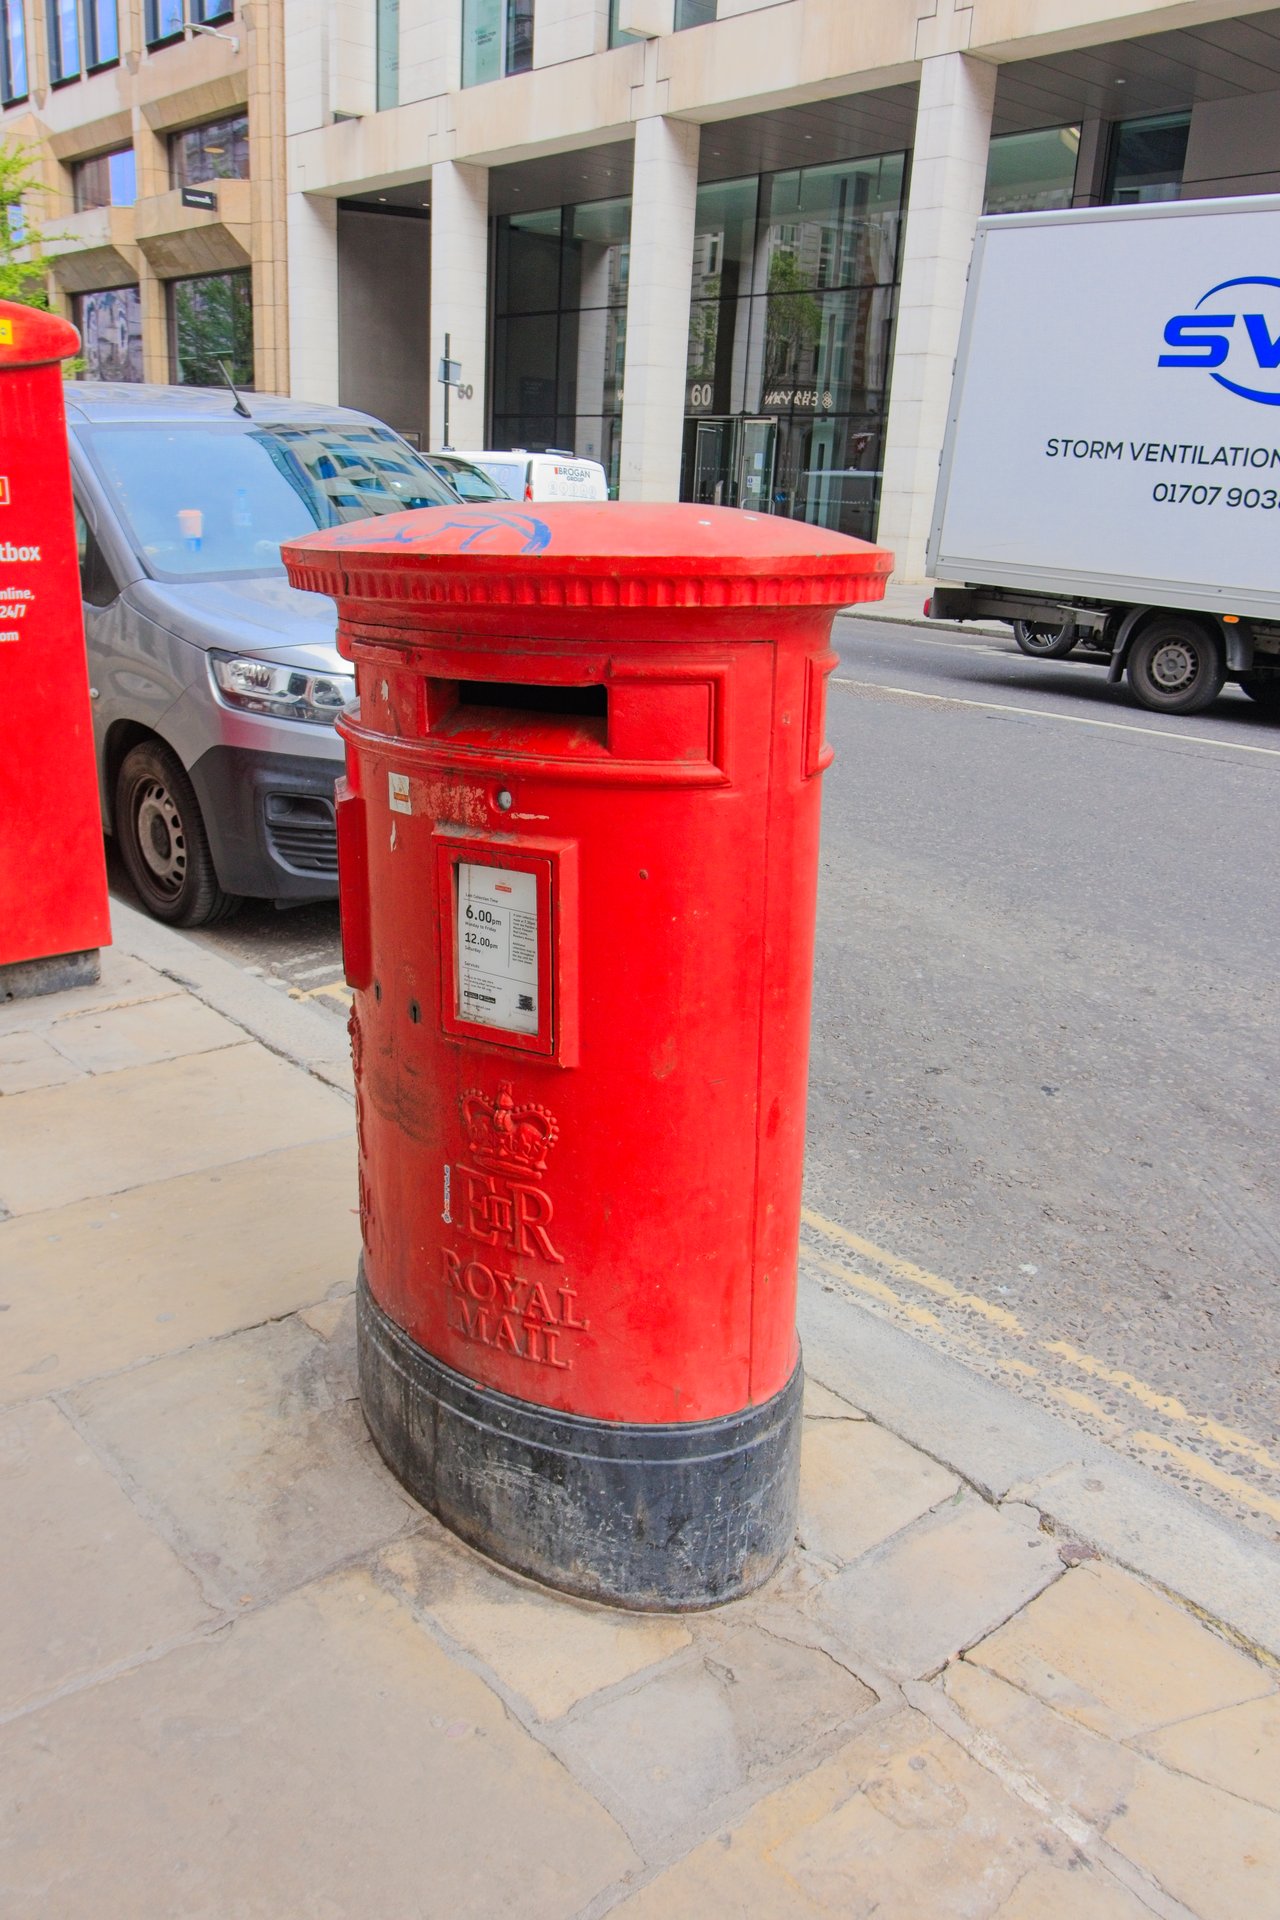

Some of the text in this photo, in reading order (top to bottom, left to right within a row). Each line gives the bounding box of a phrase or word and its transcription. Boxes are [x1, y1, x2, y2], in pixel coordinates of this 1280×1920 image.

[691, 383, 712, 407] 60
[1045, 437, 1124, 461] STORM
[558, 466, 591, 478] BROGAN
[1152, 482, 1280, 510] 01707 903
[0, 603, 27, 619] 24/7
[466, 904, 502, 926] 6.00pm
[464, 921, 480, 929] Monday
[484, 925, 497, 933] Friday
[464, 932, 499, 949] 12.00pm
[464, 945, 482, 954] Saturday
[464, 960, 480, 969] Services
[439, 1247, 590, 1332] ROYAL
[446, 1296, 574, 1371] MAIL
